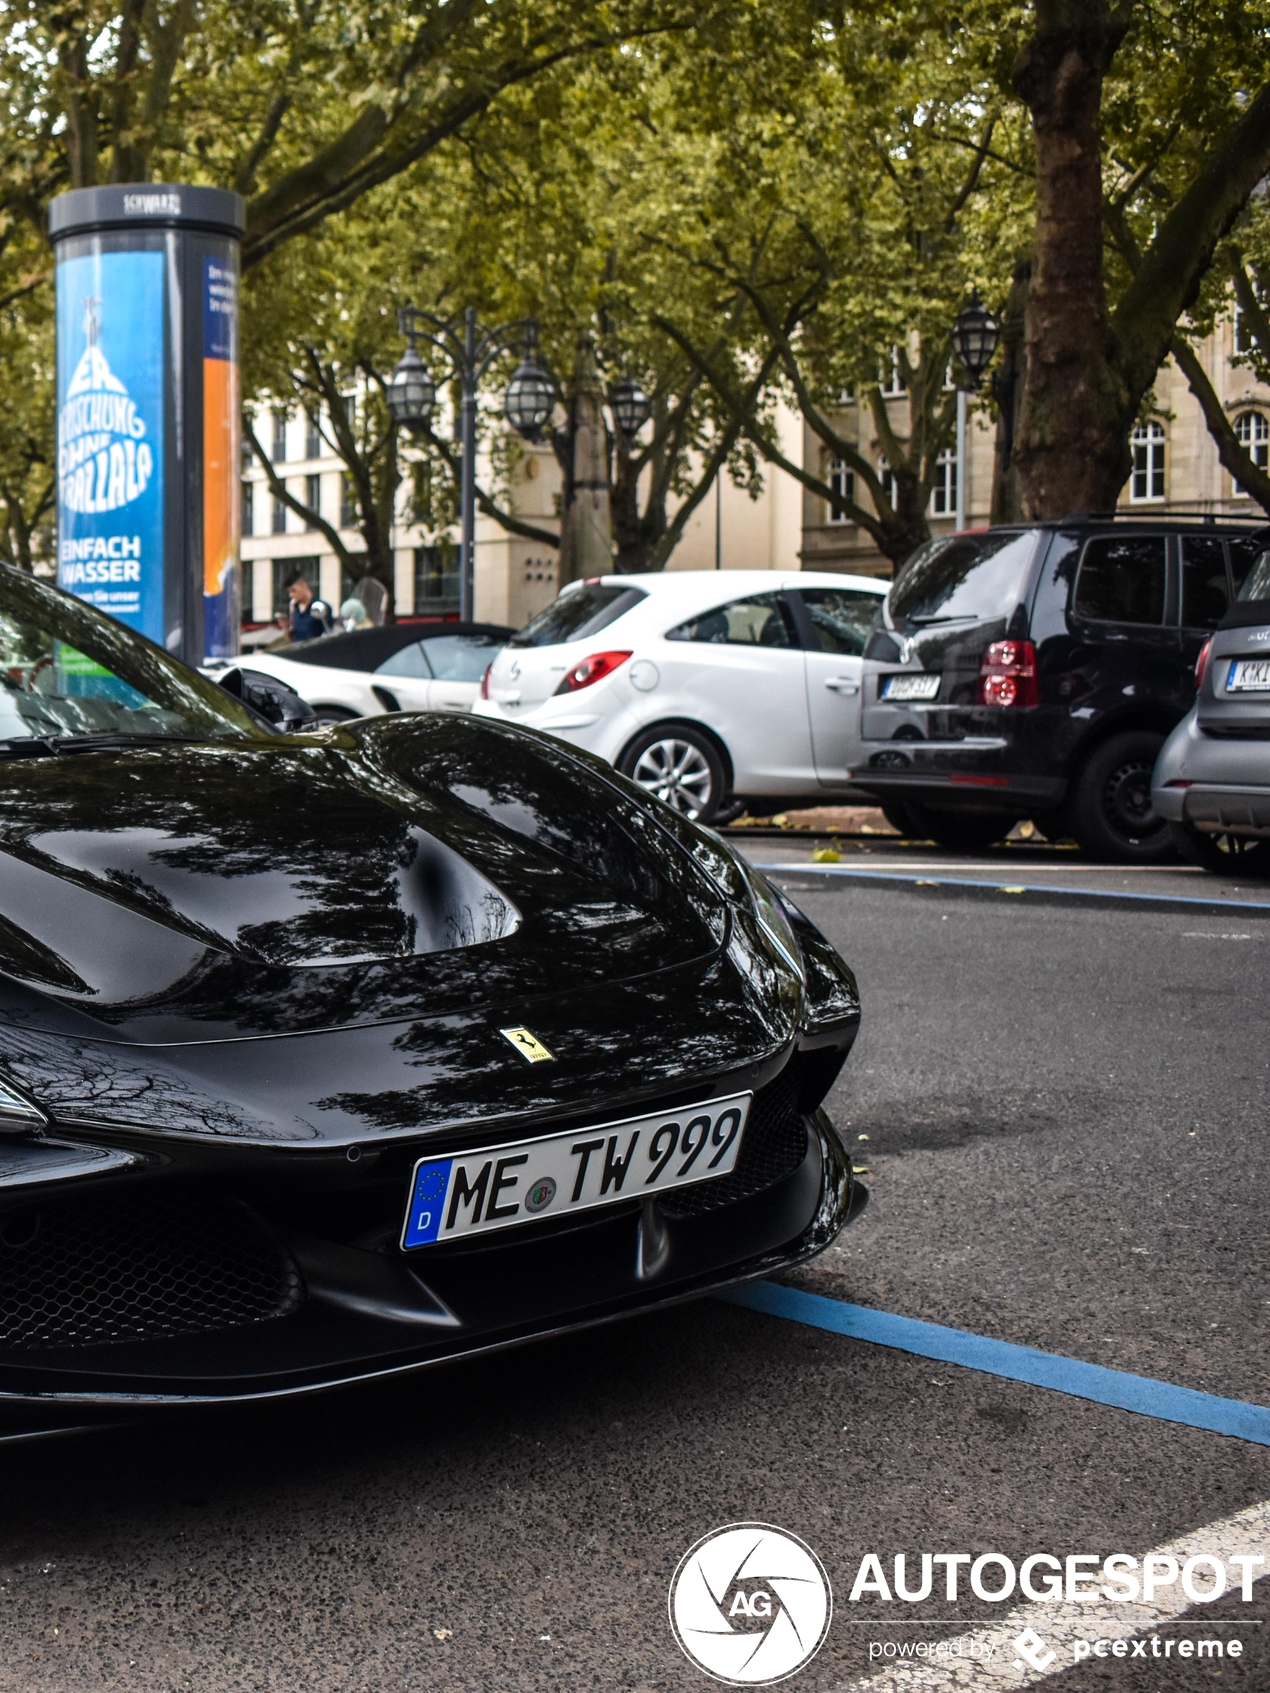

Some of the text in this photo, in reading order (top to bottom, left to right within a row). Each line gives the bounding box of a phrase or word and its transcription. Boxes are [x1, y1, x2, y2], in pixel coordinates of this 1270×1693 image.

[67, 346, 129, 399] ER
[61, 535, 141, 561] EINFACH
[62, 559, 141, 584] WASSER
[446, 1107, 742, 1229] ME TW 999
[417, 1211, 432, 1230] D
